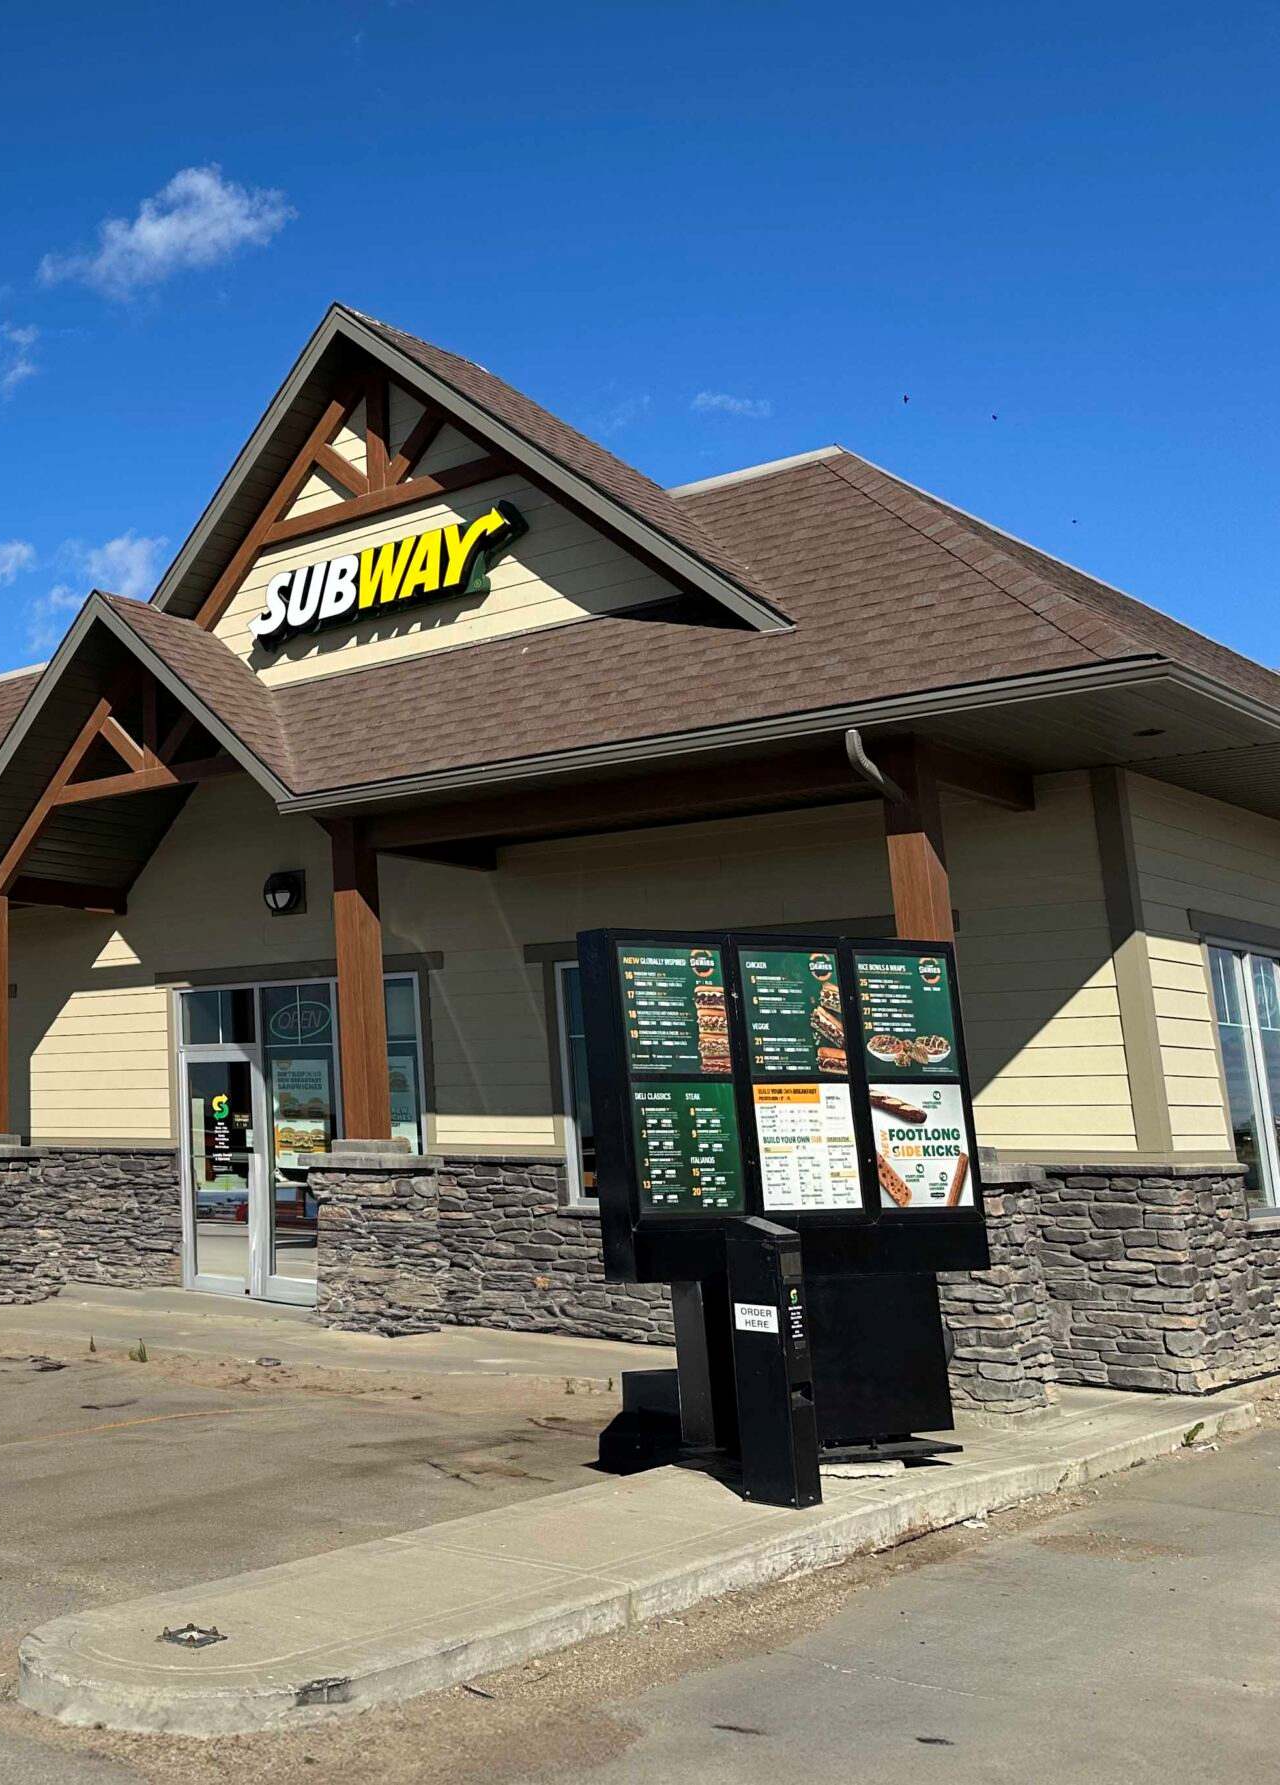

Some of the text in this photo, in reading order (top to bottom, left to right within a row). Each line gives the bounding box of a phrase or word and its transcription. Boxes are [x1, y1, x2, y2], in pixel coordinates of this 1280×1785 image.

[247, 507, 506, 637] SUBWAY
[623, 957, 639, 965] NEW
[278, 1009, 322, 1029] OPEN
[888, 1128, 961, 1141] FOOTLONG
[763, 1136, 780, 1144] BUILD
[781, 1136, 796, 1144] YOUR
[892, 1145, 961, 1157] SIDEKICKS
[692, 1168, 700, 1176] 15
[692, 1187, 701, 1196] 20
[740, 1307, 772, 1317] ORDER
[745, 1320, 770, 1329] HERE
